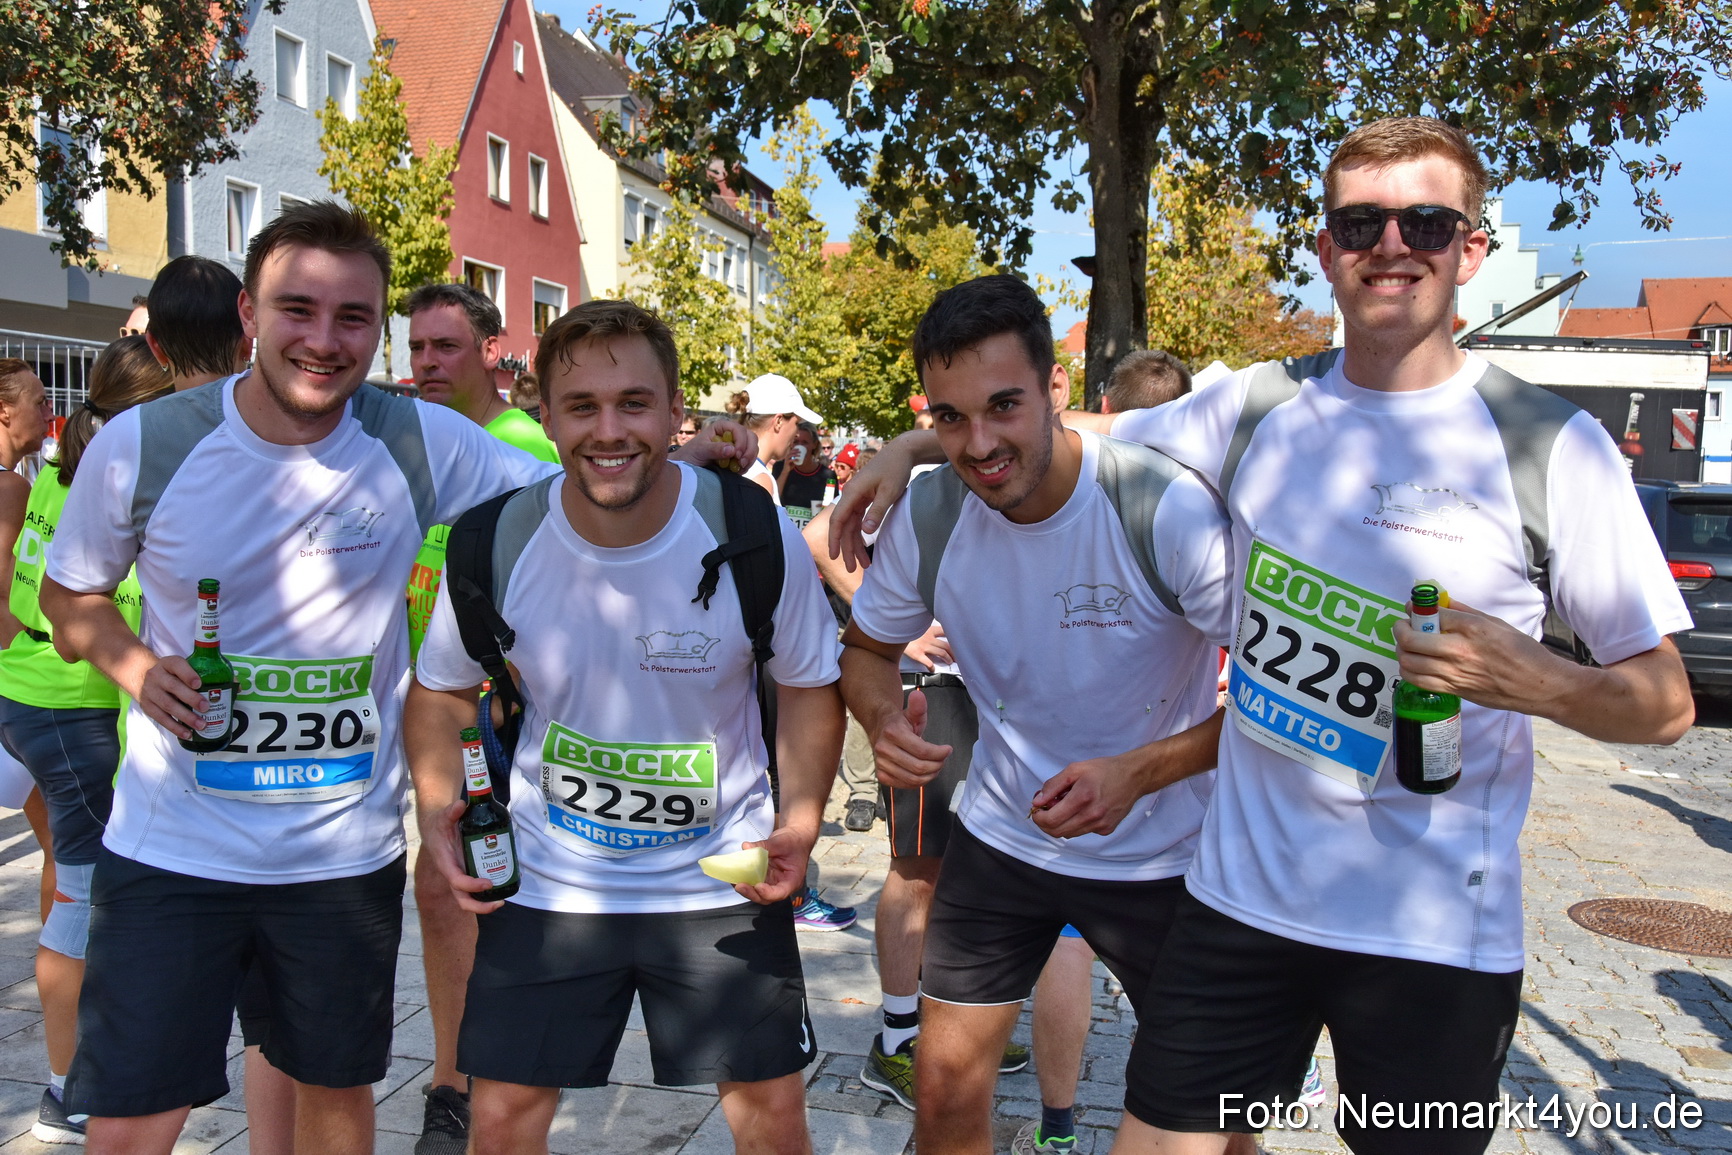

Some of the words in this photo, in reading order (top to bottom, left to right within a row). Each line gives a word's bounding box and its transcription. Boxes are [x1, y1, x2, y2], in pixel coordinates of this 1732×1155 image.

[788, 508, 812, 517] BOC
[1362, 516, 1379, 526] Die
[1380, 519, 1464, 543] Polsterwerkstatt
[300, 550, 314, 558] Die
[316, 541, 381, 556] Polsterwerkstatt
[1255, 557, 1398, 646] BOCK
[1060, 621, 1070, 629] Die
[1072, 619, 1133, 629] Polsterwerkstatt
[640, 663, 649, 672] Die
[651, 664, 717, 674] Polsterwerkstatt
[1242, 609, 1386, 719] 2228
[233, 663, 361, 697] BOCK
[363, 708, 371, 717] D
[1238, 681, 1342, 752] MATTEO
[230, 709, 364, 754] 2230
[556, 736, 697, 779] BOCK
[254, 764, 325, 786] MIRO
[561, 775, 695, 826] 2229
[561, 814, 695, 847] CHRISTIAN
[482, 857, 509, 869] Dunkel
